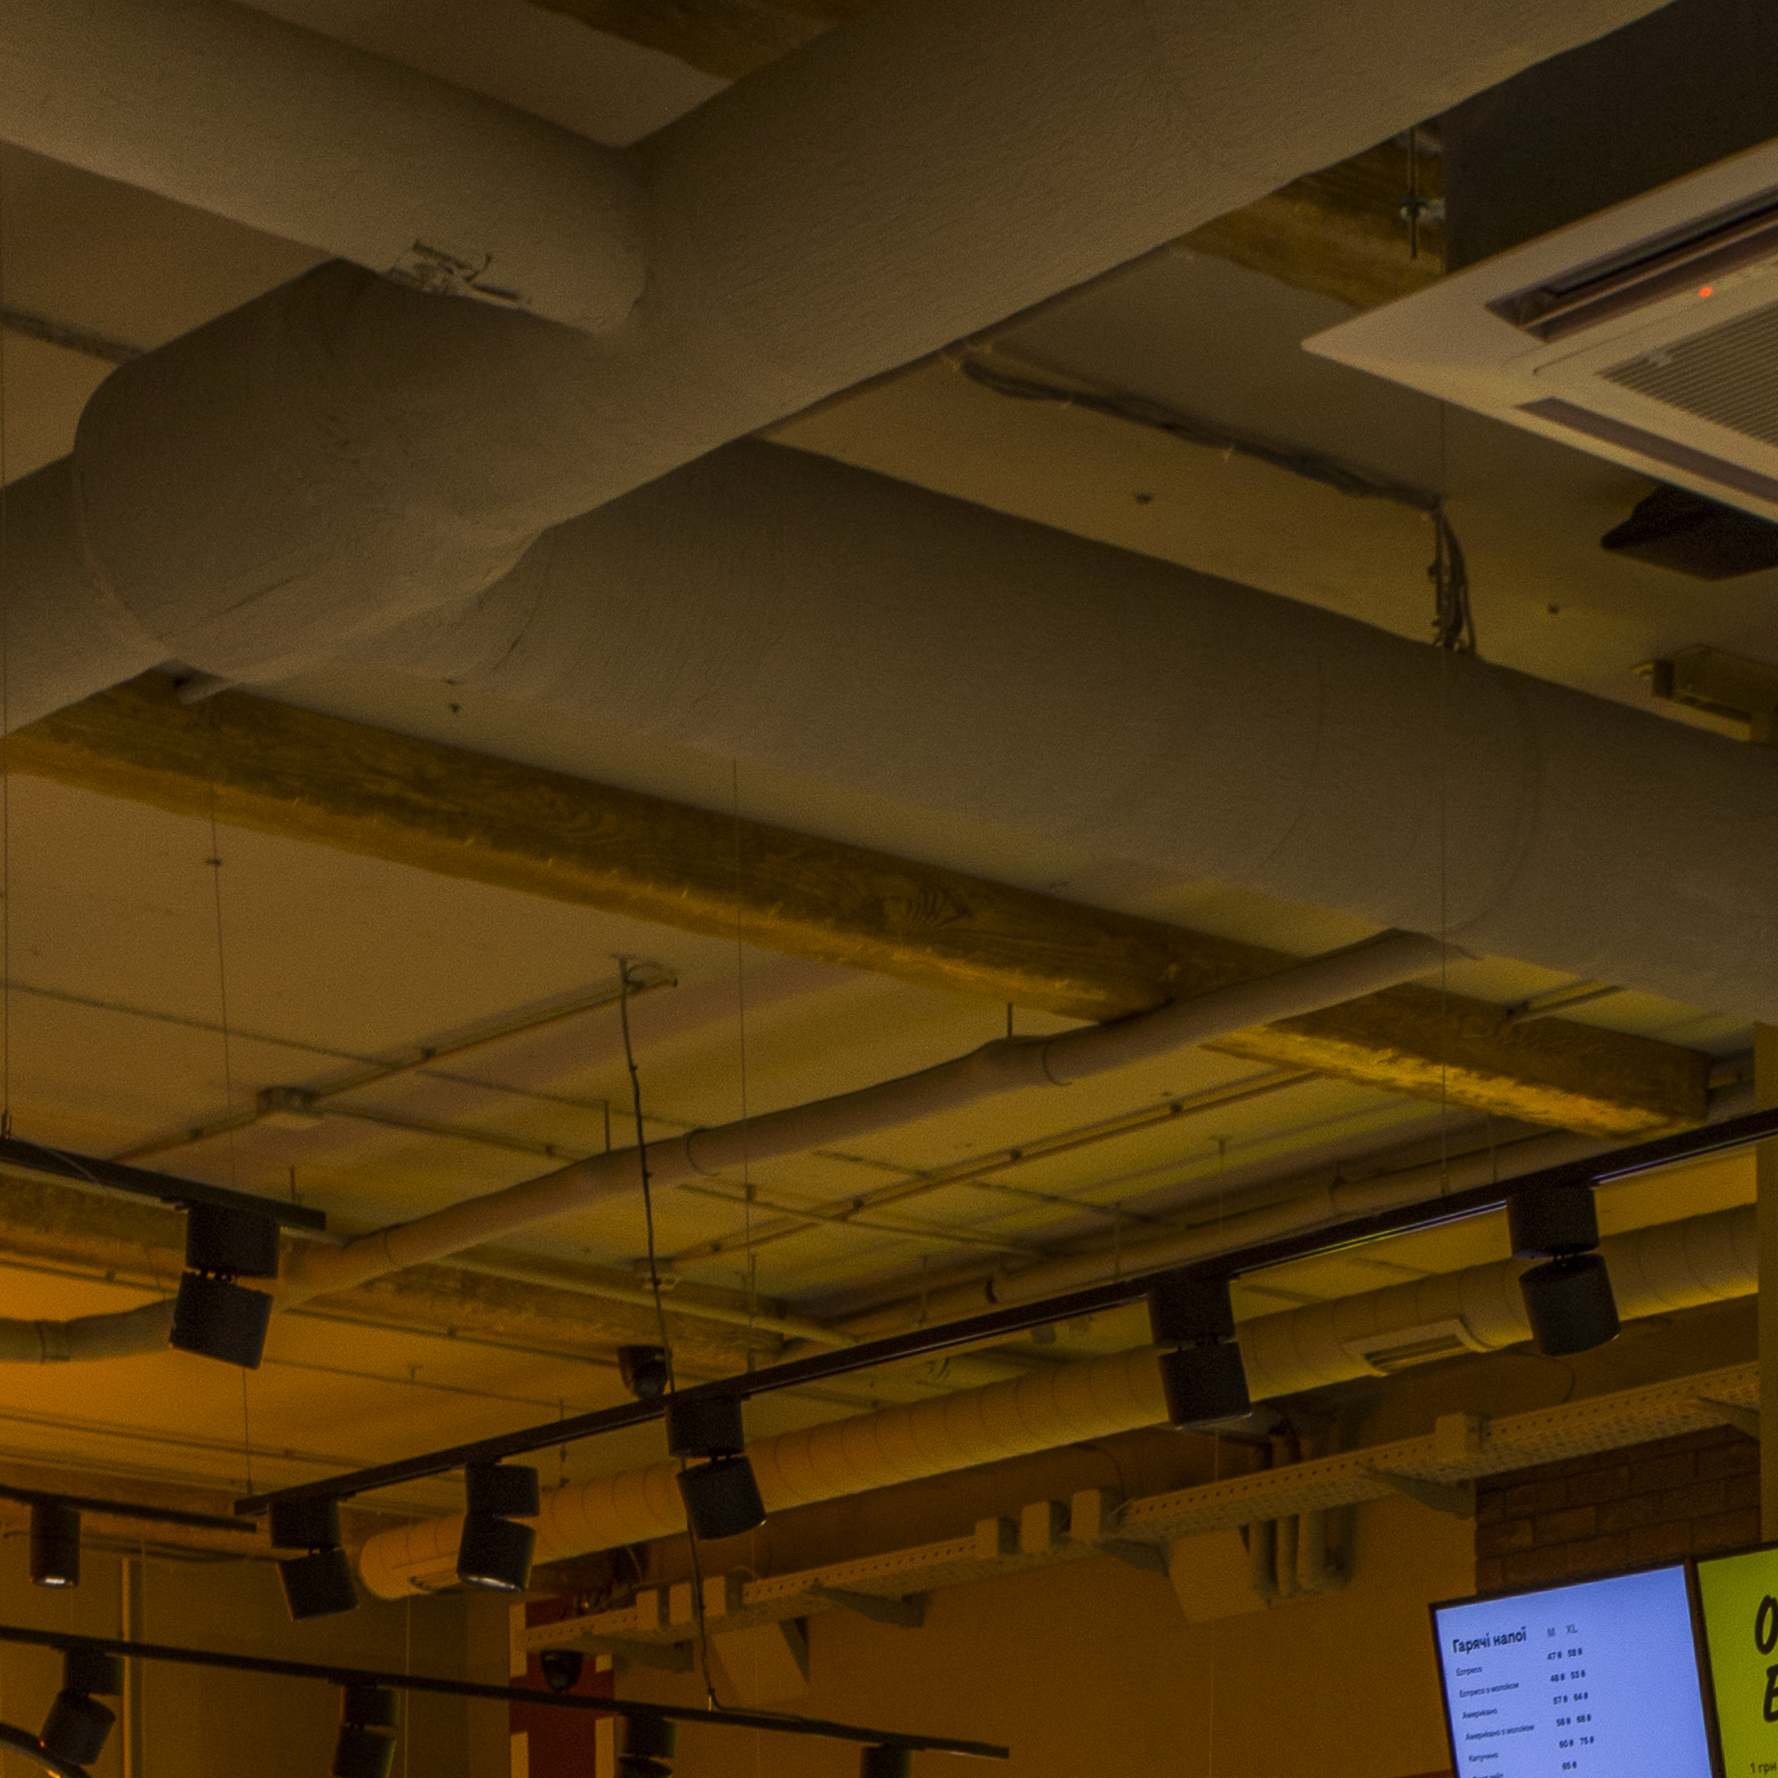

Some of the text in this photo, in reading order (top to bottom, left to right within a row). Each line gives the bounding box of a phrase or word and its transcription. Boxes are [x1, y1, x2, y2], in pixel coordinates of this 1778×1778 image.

[1453, 1626, 1527, 1655] Гарячі напої
[1758, 1760, 1778, 1776] грн
